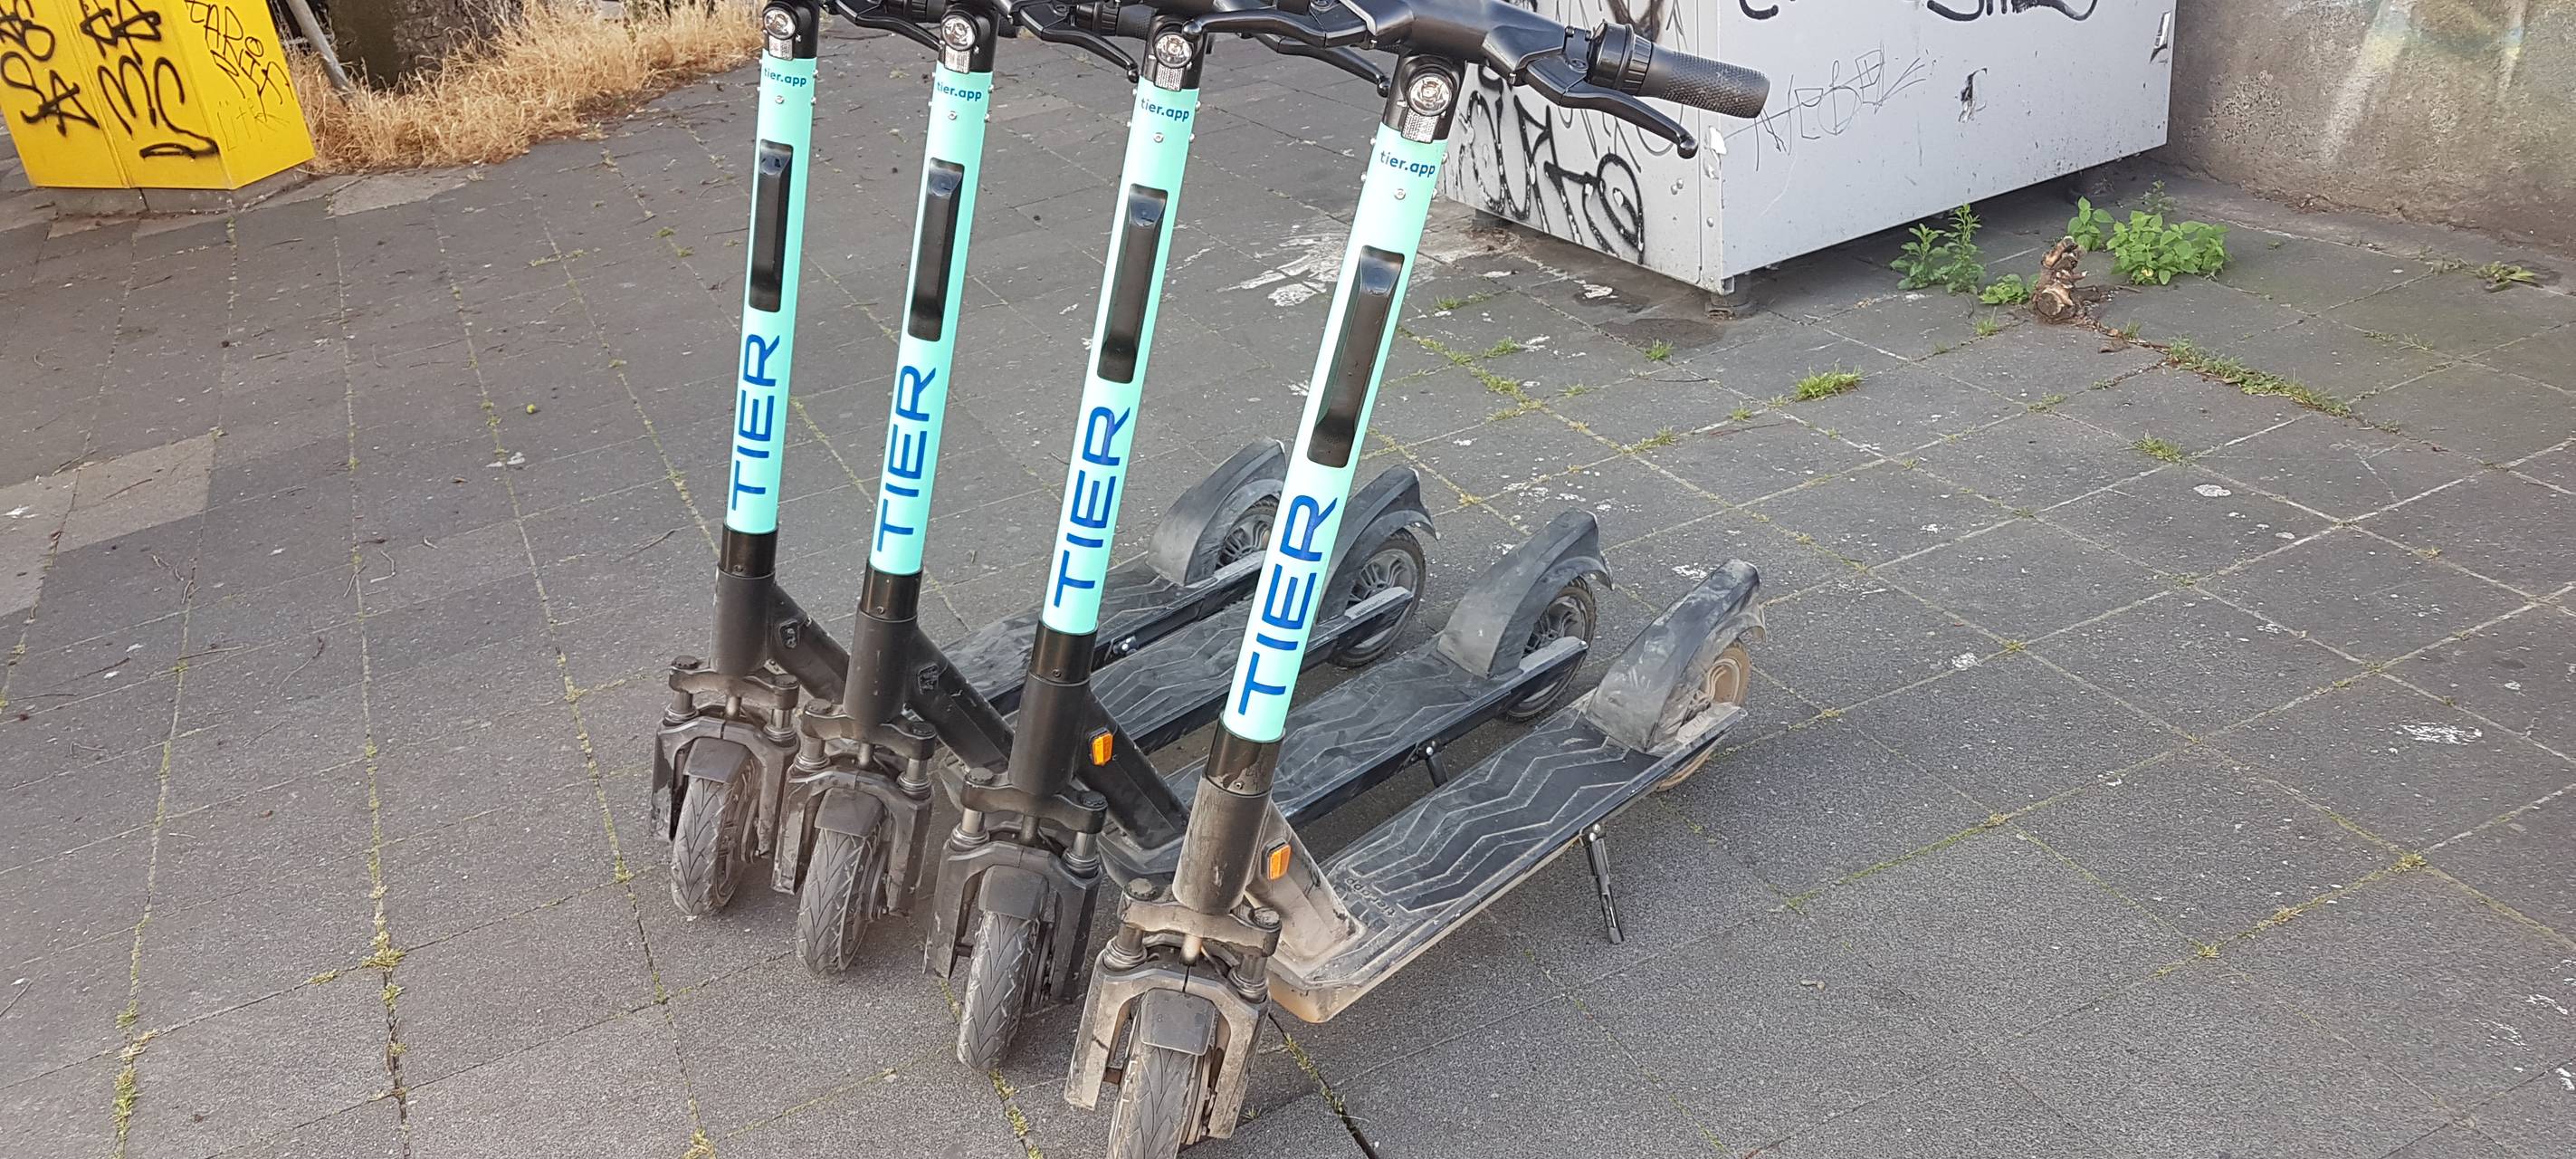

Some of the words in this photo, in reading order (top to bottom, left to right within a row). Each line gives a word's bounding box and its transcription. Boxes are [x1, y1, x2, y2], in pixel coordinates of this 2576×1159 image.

[764, 67, 807, 88] tier.app
[937, 81, 983, 102] tier.app
[1140, 97, 1190, 122] tier.app
[1380, 150, 1436, 178] tier.app
[732, 334, 779, 508] TIER
[876, 366, 935, 551] TIER
[1054, 407, 1130, 608] TIER
[1238, 495, 1336, 715] TIER
